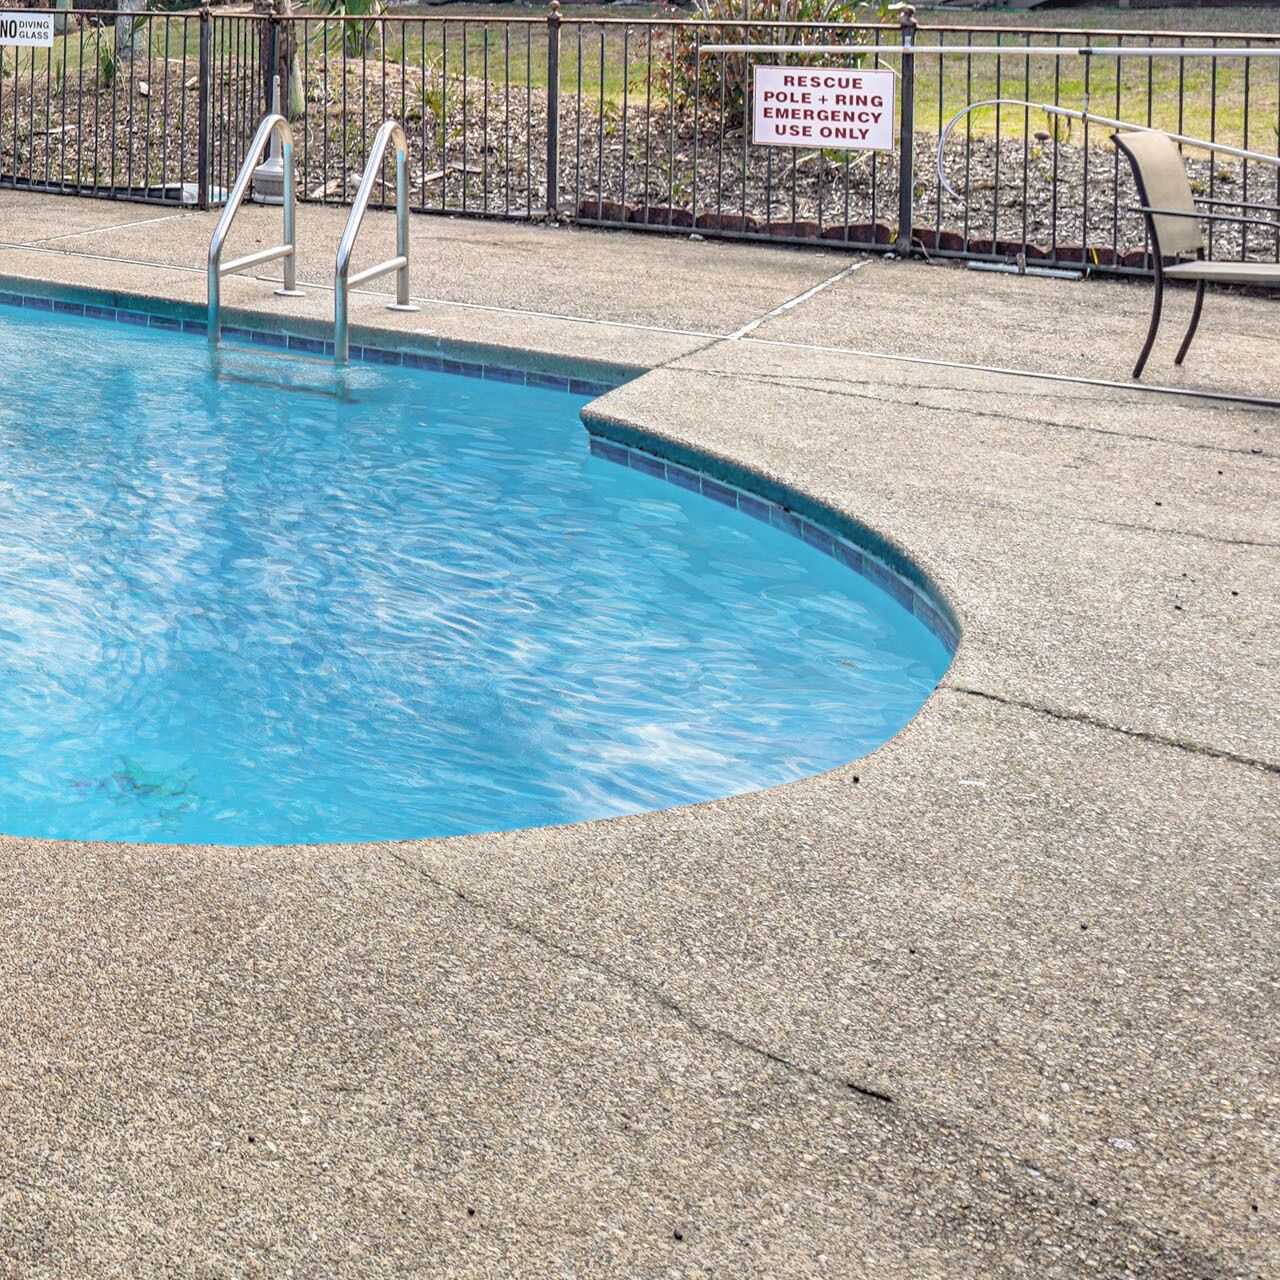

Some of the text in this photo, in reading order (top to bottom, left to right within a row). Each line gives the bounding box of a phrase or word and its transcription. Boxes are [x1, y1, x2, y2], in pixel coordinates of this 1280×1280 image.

[0, 20, 49, 38] NO DIVING
[19, 31, 49, 40] GLASS
[783, 75, 863, 90] RESCUE
[763, 91, 883, 108] POLE + RING
[763, 107, 882, 124] EMERGENCY
[775, 124, 870, 140] USE ONLY
